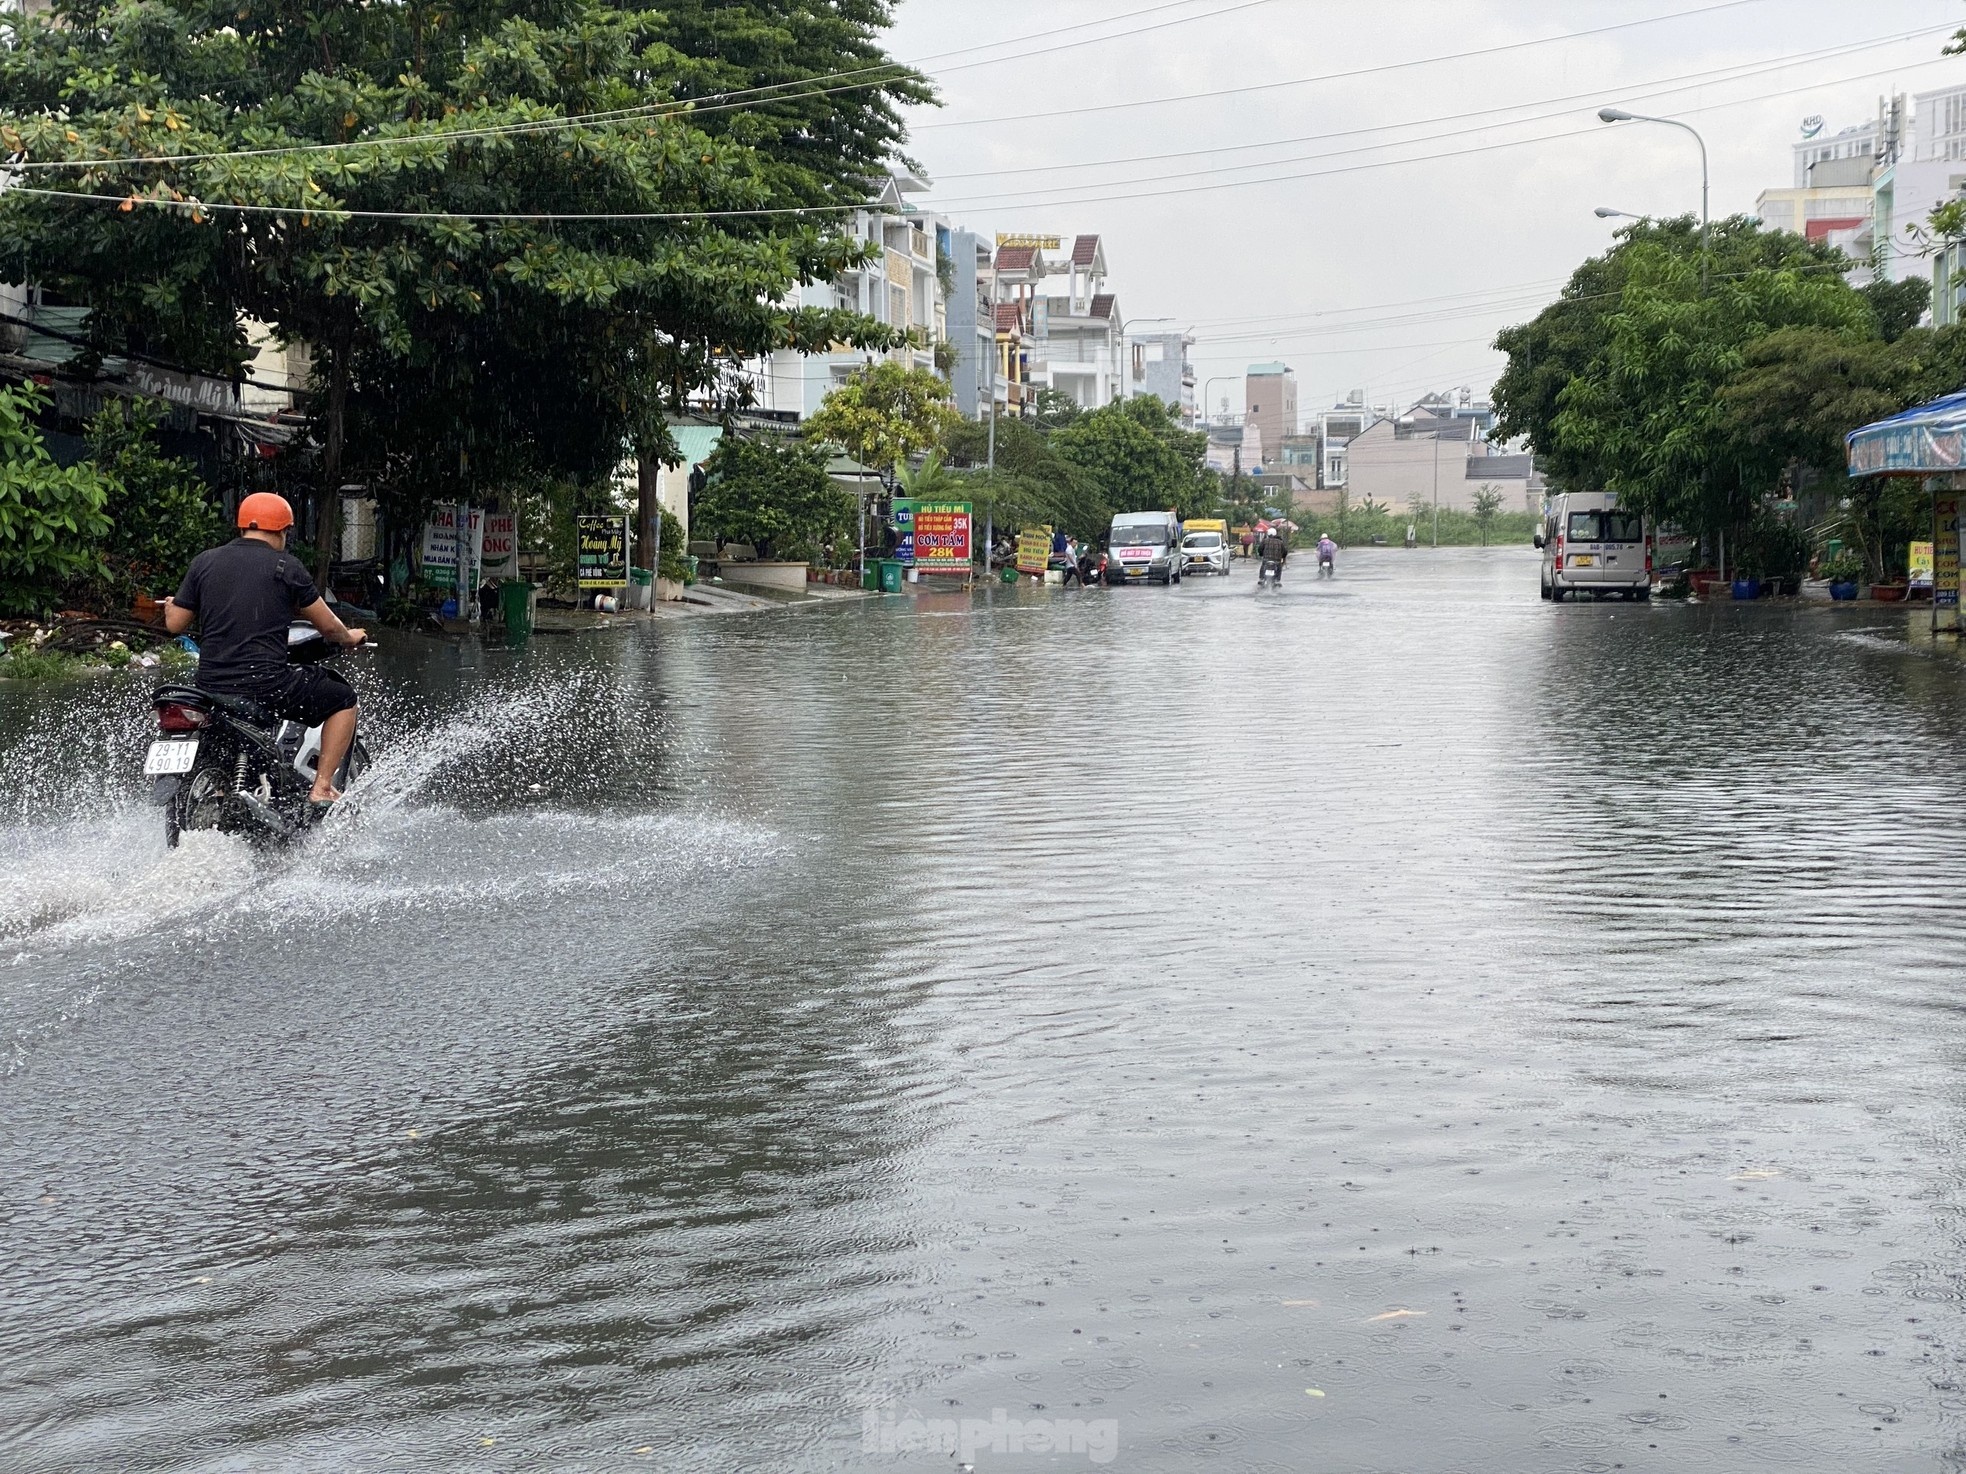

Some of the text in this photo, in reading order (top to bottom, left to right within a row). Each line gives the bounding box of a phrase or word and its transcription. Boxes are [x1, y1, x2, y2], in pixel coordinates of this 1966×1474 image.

[921, 503, 964, 513] HỦ TIẾU MÌ
[491, 516, 513, 532] PHÊ
[579, 518, 604, 531] Coffee
[953, 518, 968, 529] 35K
[581, 535, 607, 552] Hoàng
[918, 530, 965, 546] CƠM TẤM
[929, 548, 954, 557] 28K
[156, 743, 189, 756] 29-Y1
[149, 757, 190, 771] 490.19
